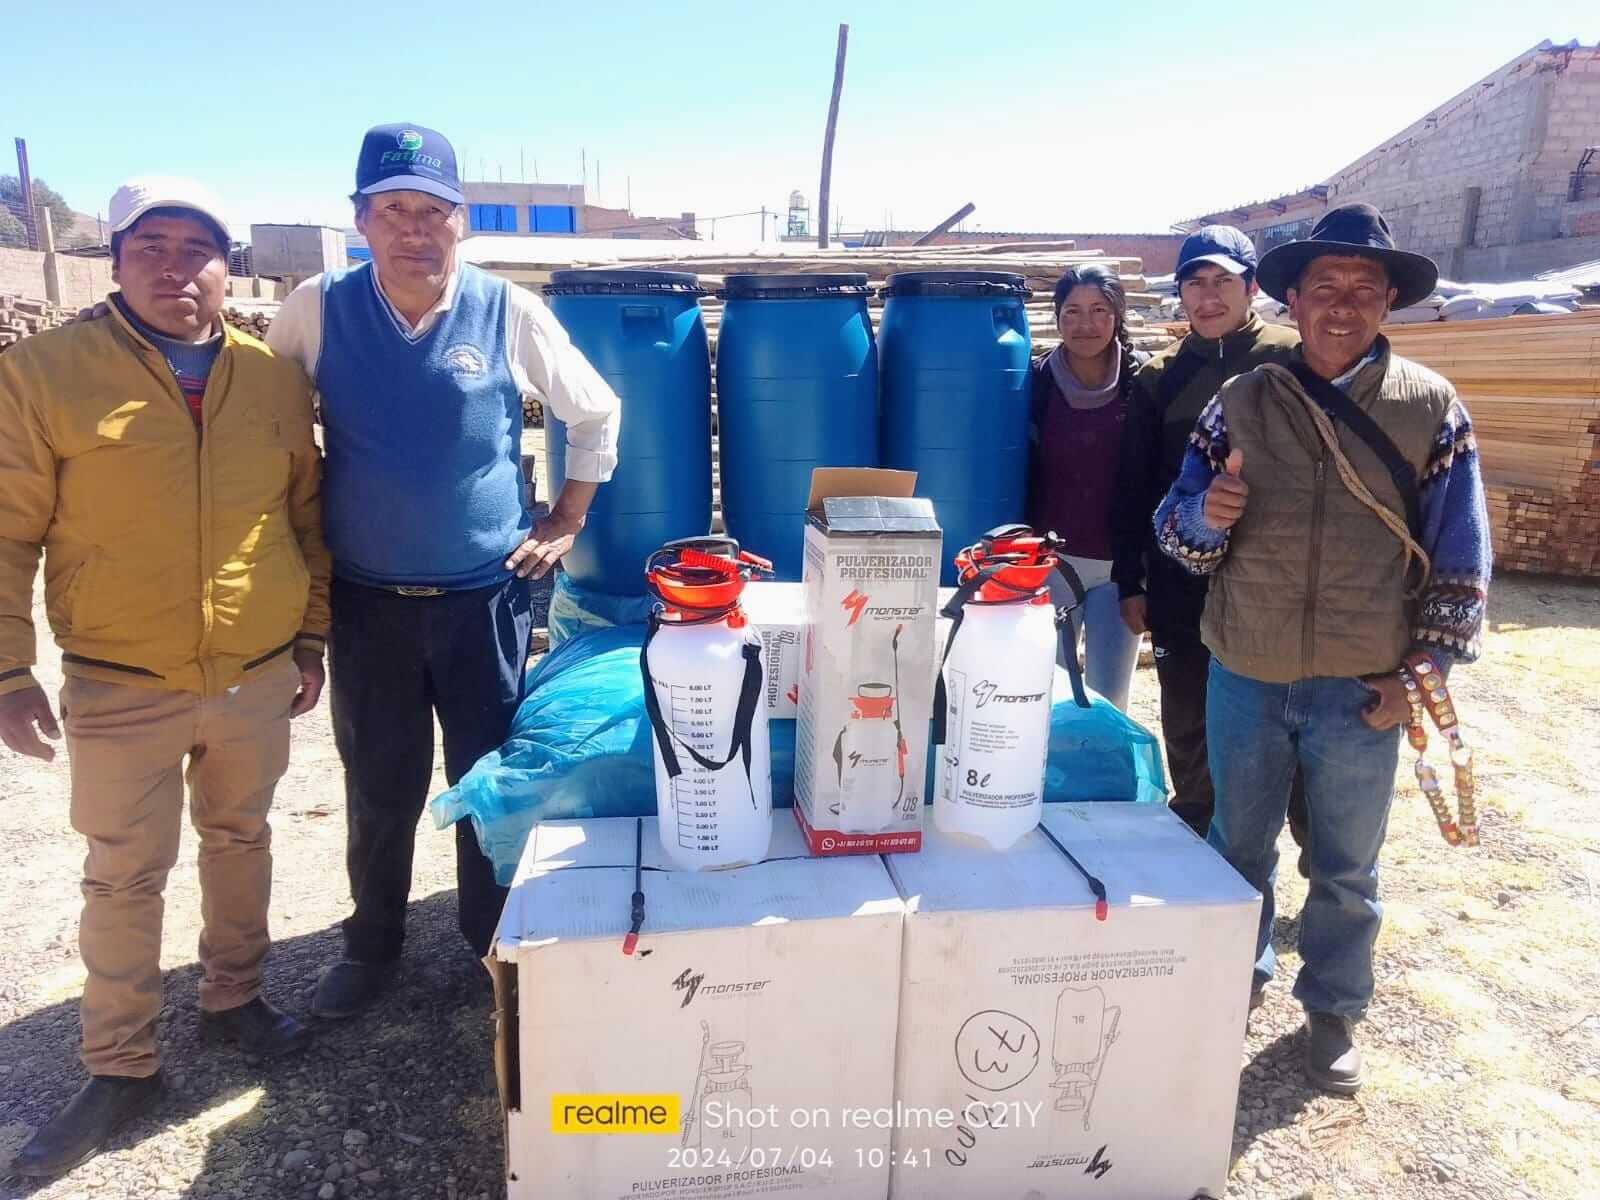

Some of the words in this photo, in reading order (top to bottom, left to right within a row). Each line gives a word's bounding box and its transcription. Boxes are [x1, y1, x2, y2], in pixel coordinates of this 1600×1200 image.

[836, 555, 932, 567] PULVERIZADOR
[840, 567, 928, 579] PROFESIONAL
[864, 606, 925, 616] monster
[768, 634, 781, 708] PROFESIONAL
[1011, 971, 1088, 985] PROFESIONAL
[1091, 964, 1174, 981] PULVERIZADOR
[700, 979, 772, 994] monster
[1026, 1157, 1089, 1168] monster
[632, 1173, 723, 1193] PULVERIZADOR
[726, 1164, 805, 1184] PROFESIONAL
